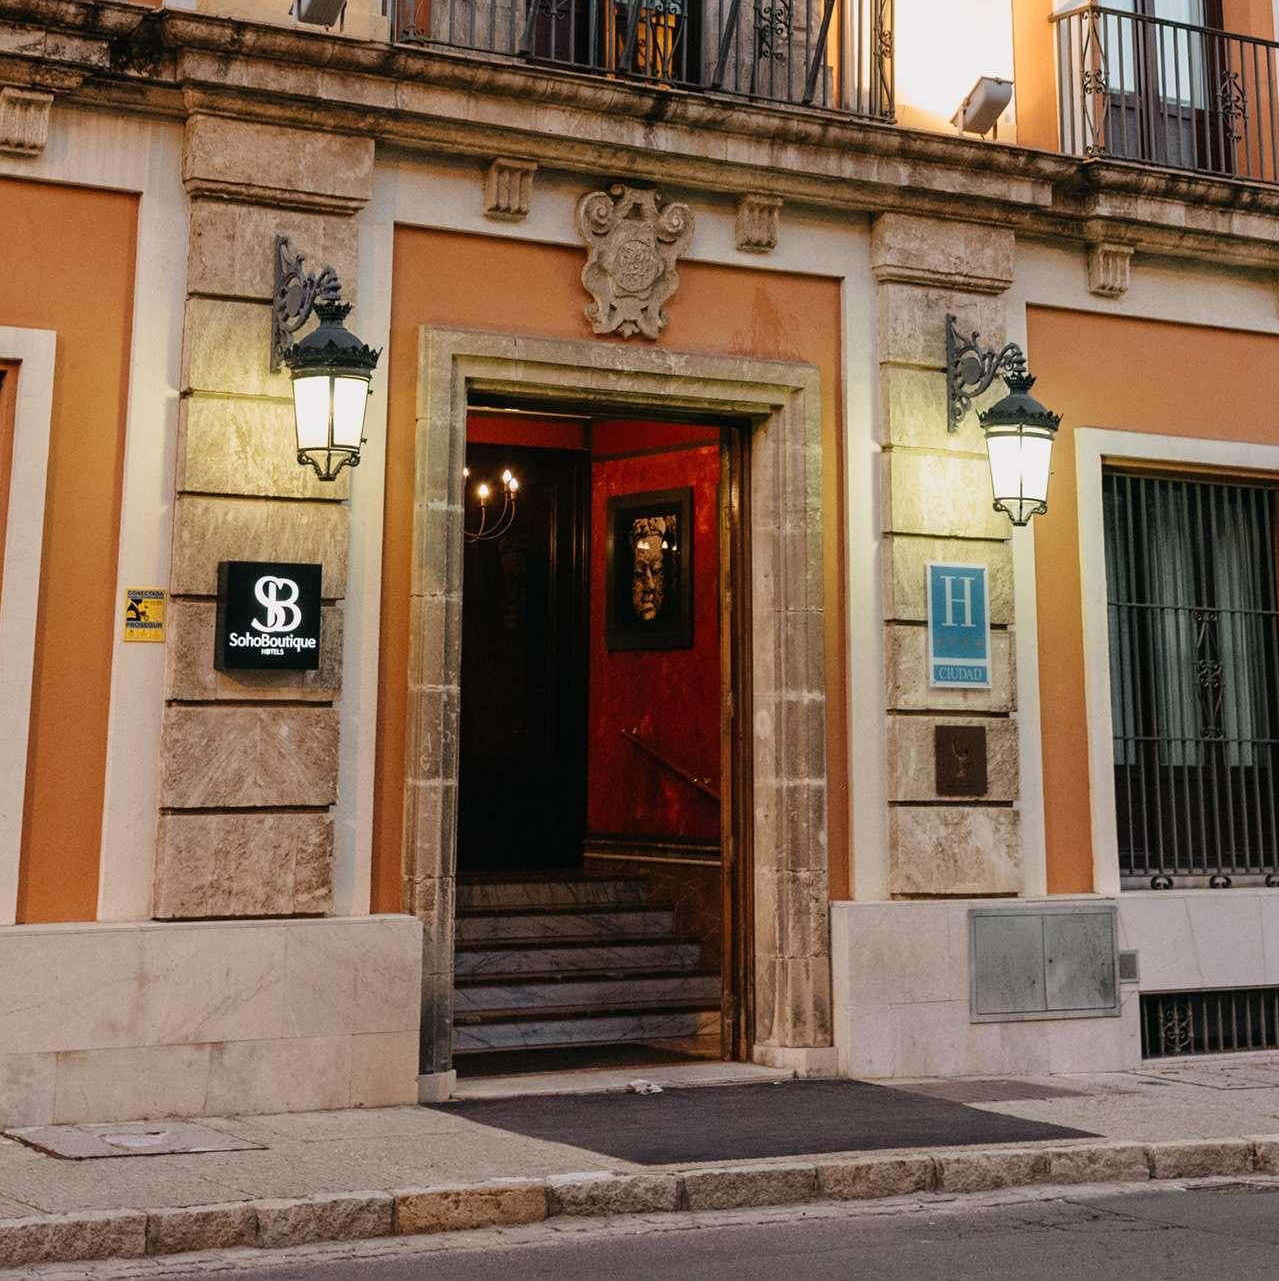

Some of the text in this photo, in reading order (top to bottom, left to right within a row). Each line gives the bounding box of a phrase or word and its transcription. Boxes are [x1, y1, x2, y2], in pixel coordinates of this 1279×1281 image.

[940, 575, 977, 628] H
[229, 632, 316, 652] SohoBoutique
[261, 648, 284, 656] HOTELS
[939, 666, 982, 681] CIUDAD
